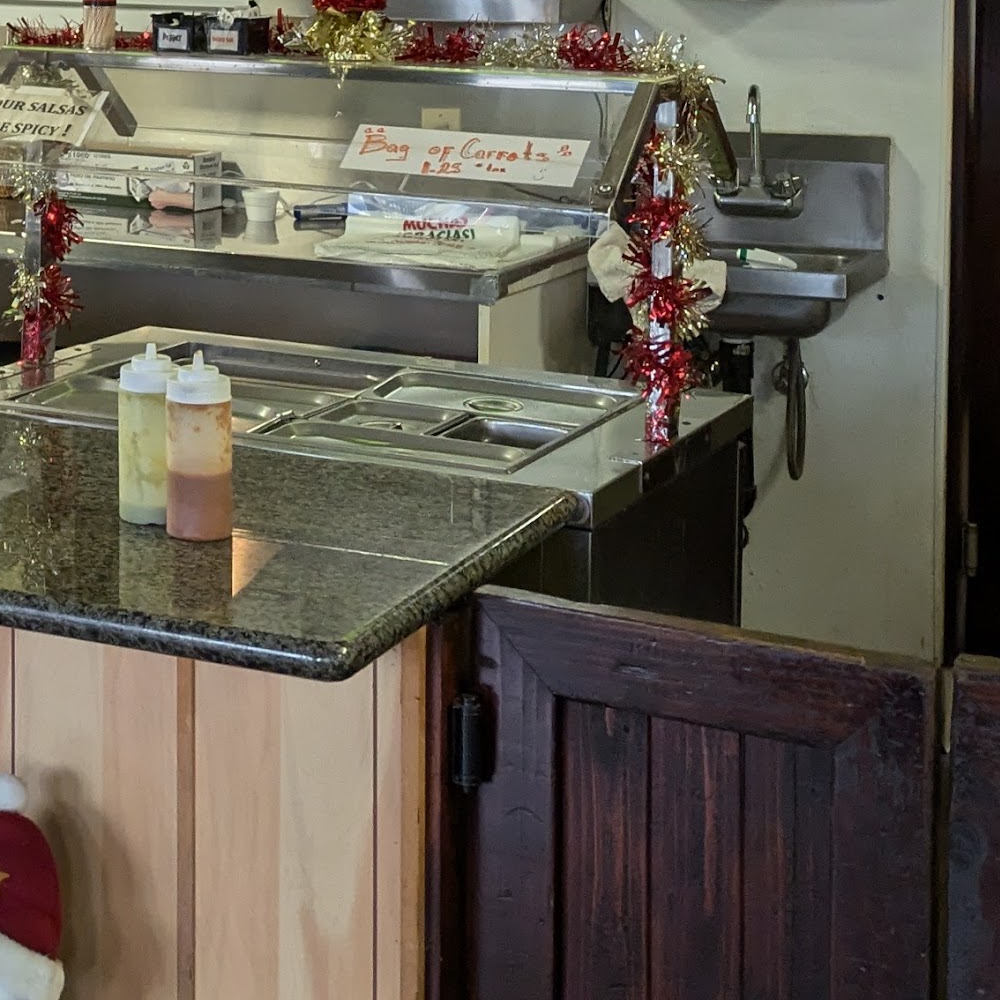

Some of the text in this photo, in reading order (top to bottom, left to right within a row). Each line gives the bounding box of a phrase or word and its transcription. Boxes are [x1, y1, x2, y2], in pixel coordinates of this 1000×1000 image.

[28, 102, 87, 115] SALSAS
[12, 123, 60, 136] SPICY
[359, 134, 410, 162] Bag
[460, 138, 549, 162] Carrots
